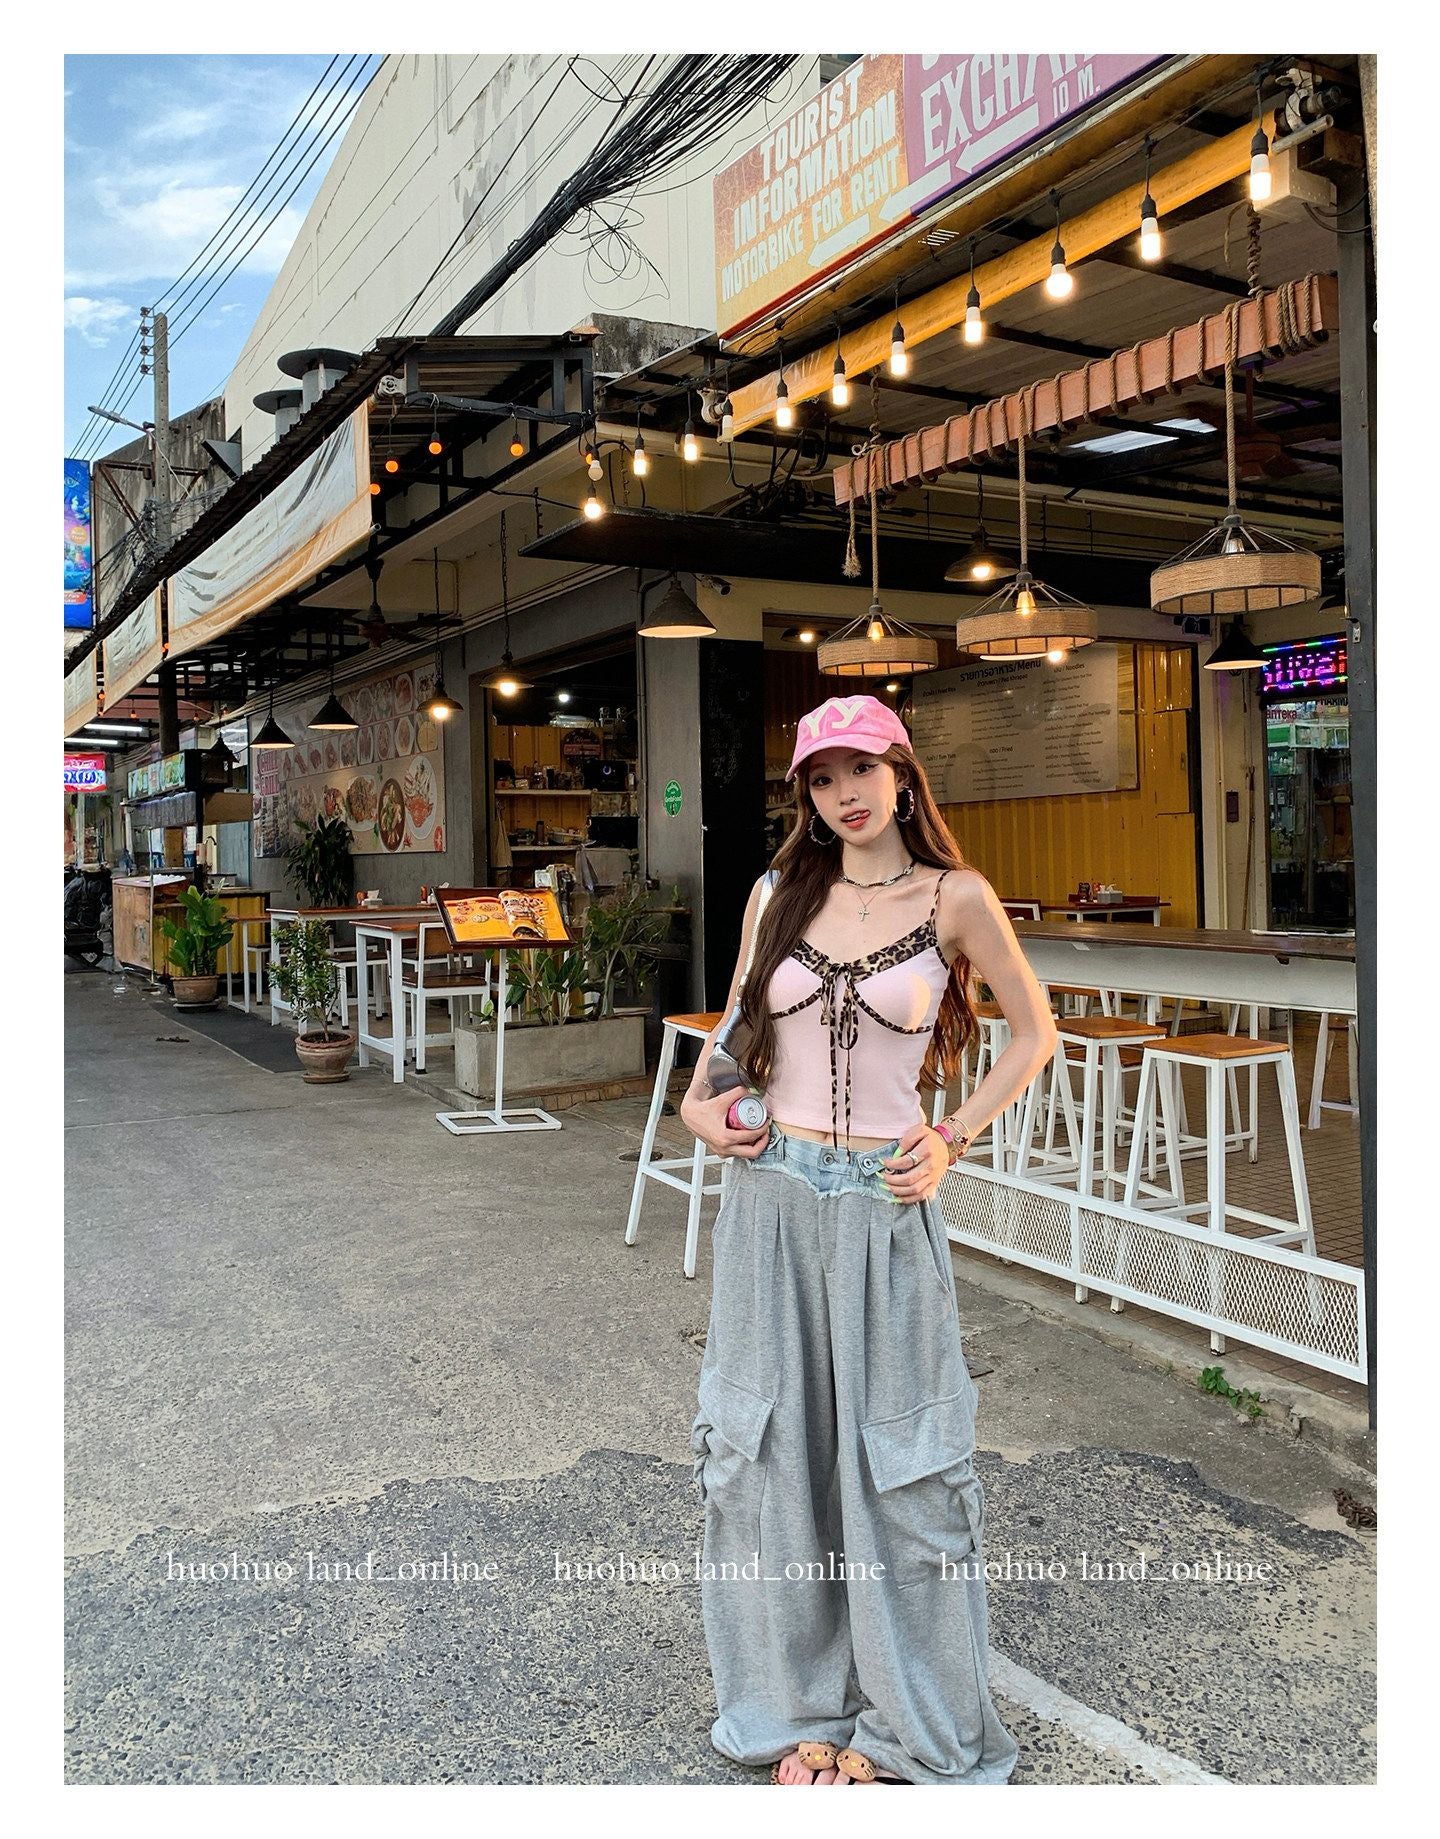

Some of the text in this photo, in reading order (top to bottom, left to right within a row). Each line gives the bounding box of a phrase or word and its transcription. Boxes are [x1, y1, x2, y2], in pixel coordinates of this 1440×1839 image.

[760, 62, 864, 181] TOURIST
[920, 54, 1097, 167] EXCH
[1077, 64, 1101, 103] M.
[721, 144, 901, 304] MOTORBIKE FOR RENT
[734, 89, 897, 251] INFORMATION
